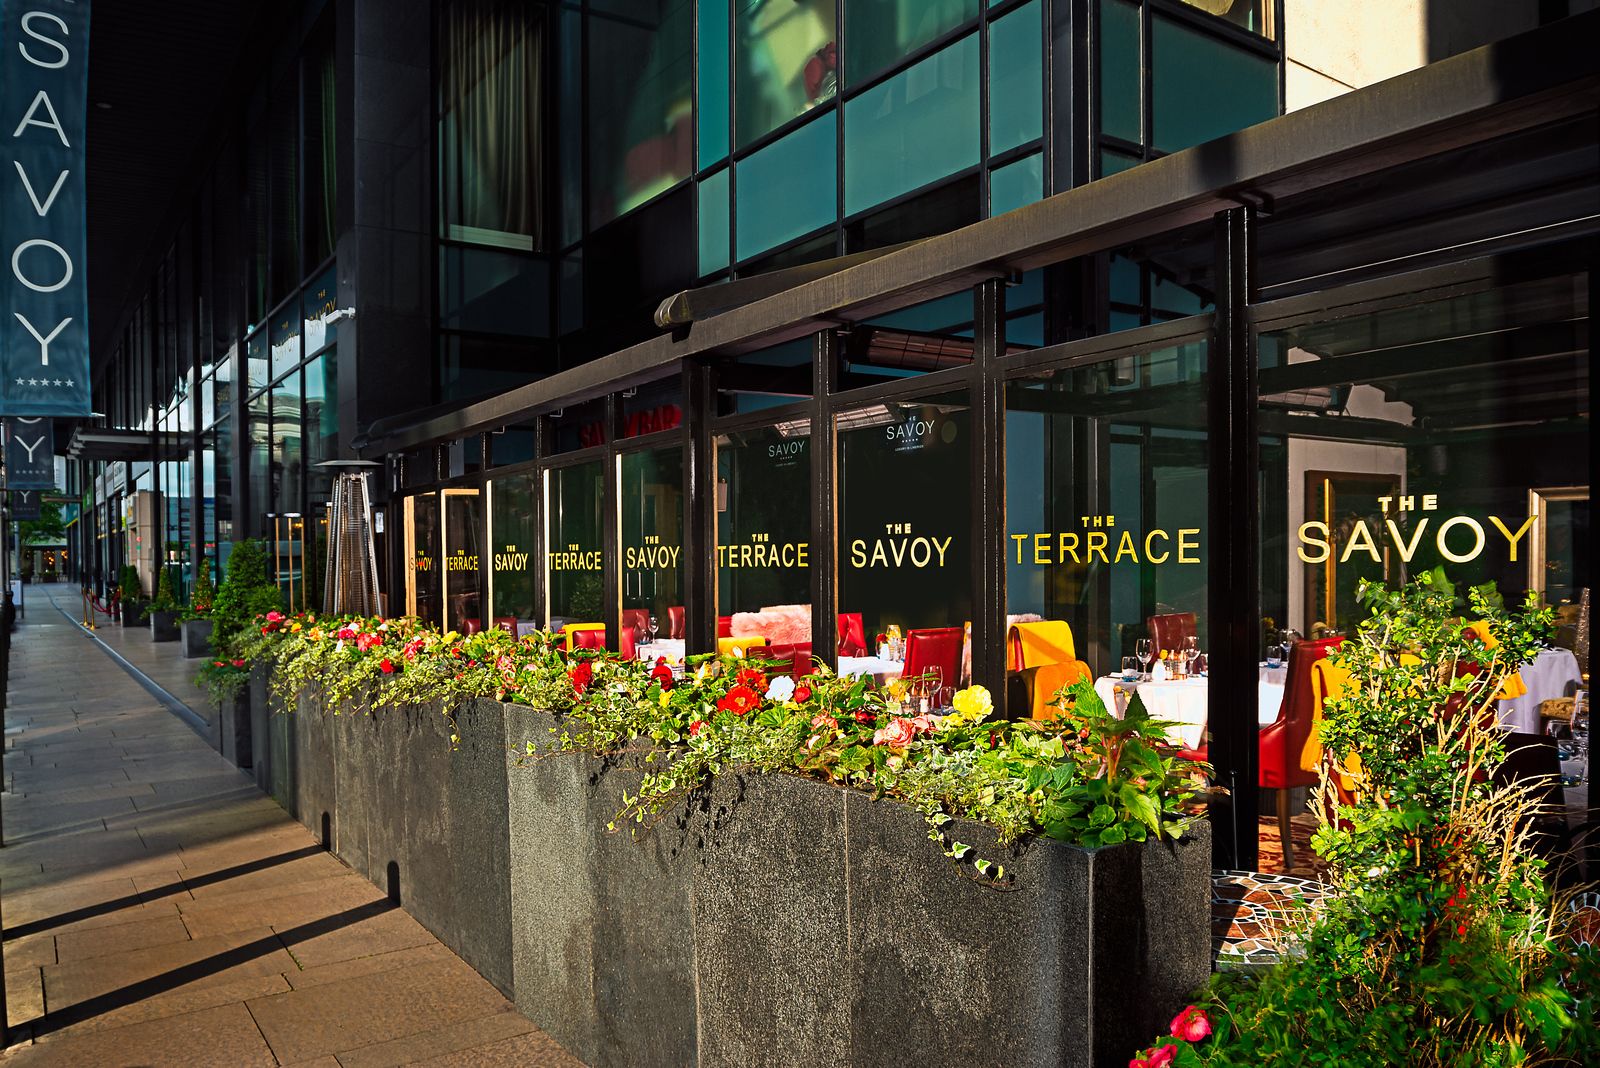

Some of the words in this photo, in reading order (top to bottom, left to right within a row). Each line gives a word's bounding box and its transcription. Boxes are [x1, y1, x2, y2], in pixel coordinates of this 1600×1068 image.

[11, 11, 74, 366] SAVOY
[886, 419, 935, 440] SAVOY
[768, 440, 805, 458] SAVOY
[1377, 494, 1438, 512] THE
[886, 523, 912, 534] THE
[1081, 515, 1115, 527] THE
[644, 535, 659, 544] THE
[751, 533, 769, 542] THE
[1010, 528, 1201, 565] TERRACE
[1297, 514, 1538, 564] SAVOY
[549, 551, 602, 570] TERRACE
[626, 545, 681, 569] SAVOY
[717, 542, 809, 568] TERRACE
[851, 536, 952, 569] SAVOY
[410, 557, 433, 571] SAVOY
[446, 555, 479, 571] TERRACE
[495, 553, 528, 571] SAVOY
